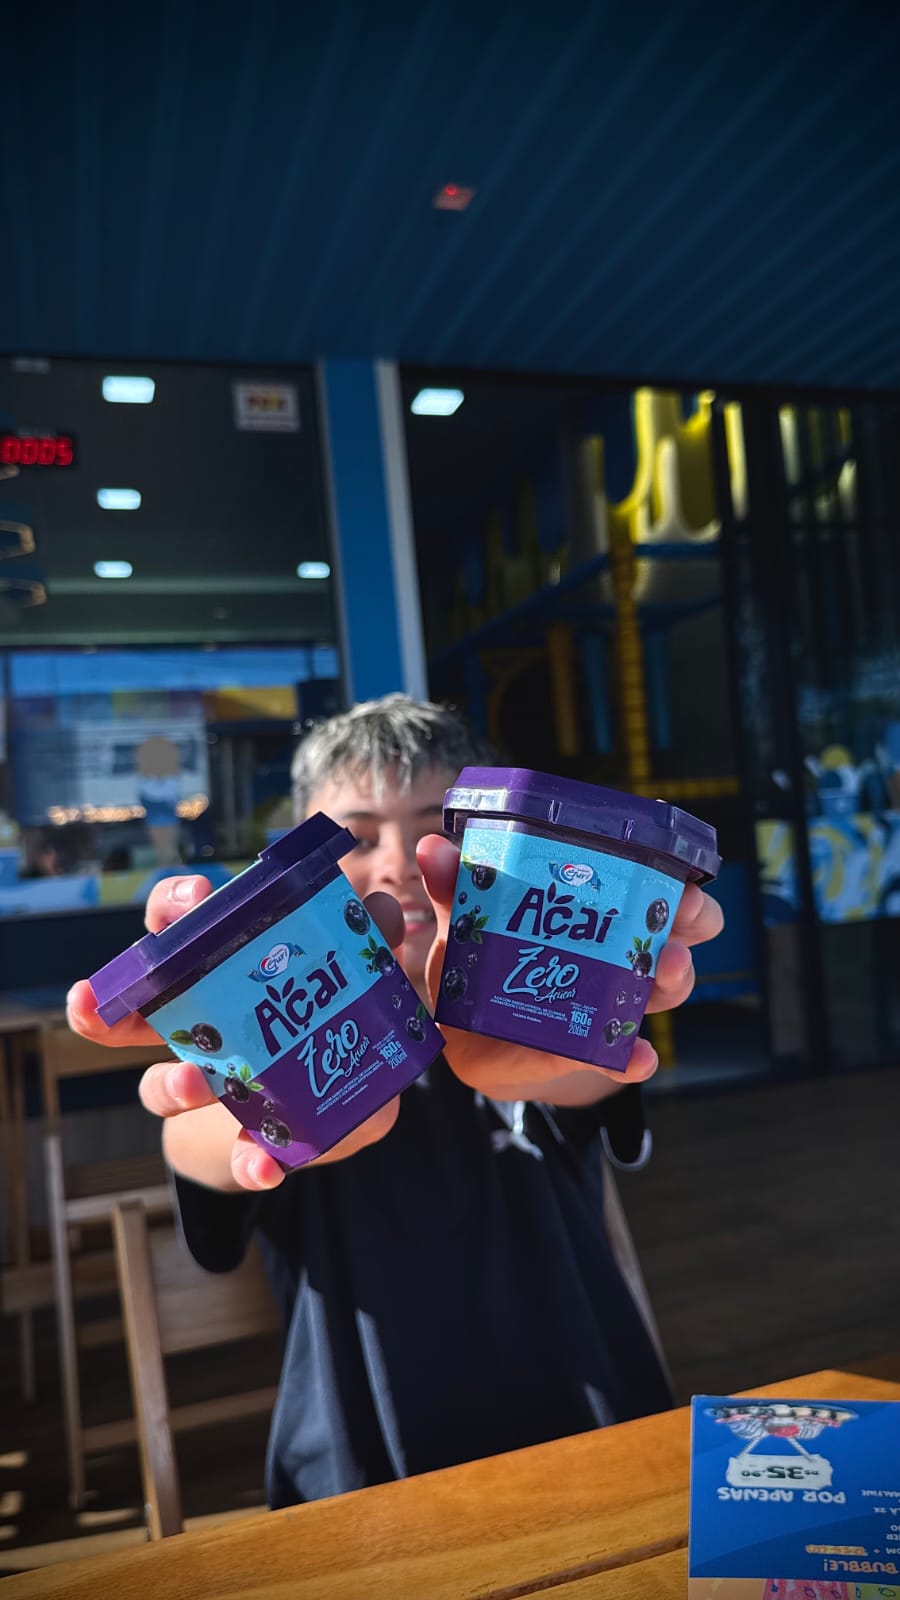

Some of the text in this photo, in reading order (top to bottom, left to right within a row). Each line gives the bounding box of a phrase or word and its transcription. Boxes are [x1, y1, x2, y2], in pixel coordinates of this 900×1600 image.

[505, 886, 620, 944] Açaí
[502, 946, 580, 996] Zero
[254, 950, 349, 1057] Açaí
[297, 1019, 359, 1098] Zero
[717, 1486, 846, 1504] POR APENAS
[823, 1558, 899, 1574] BUBBLE!
